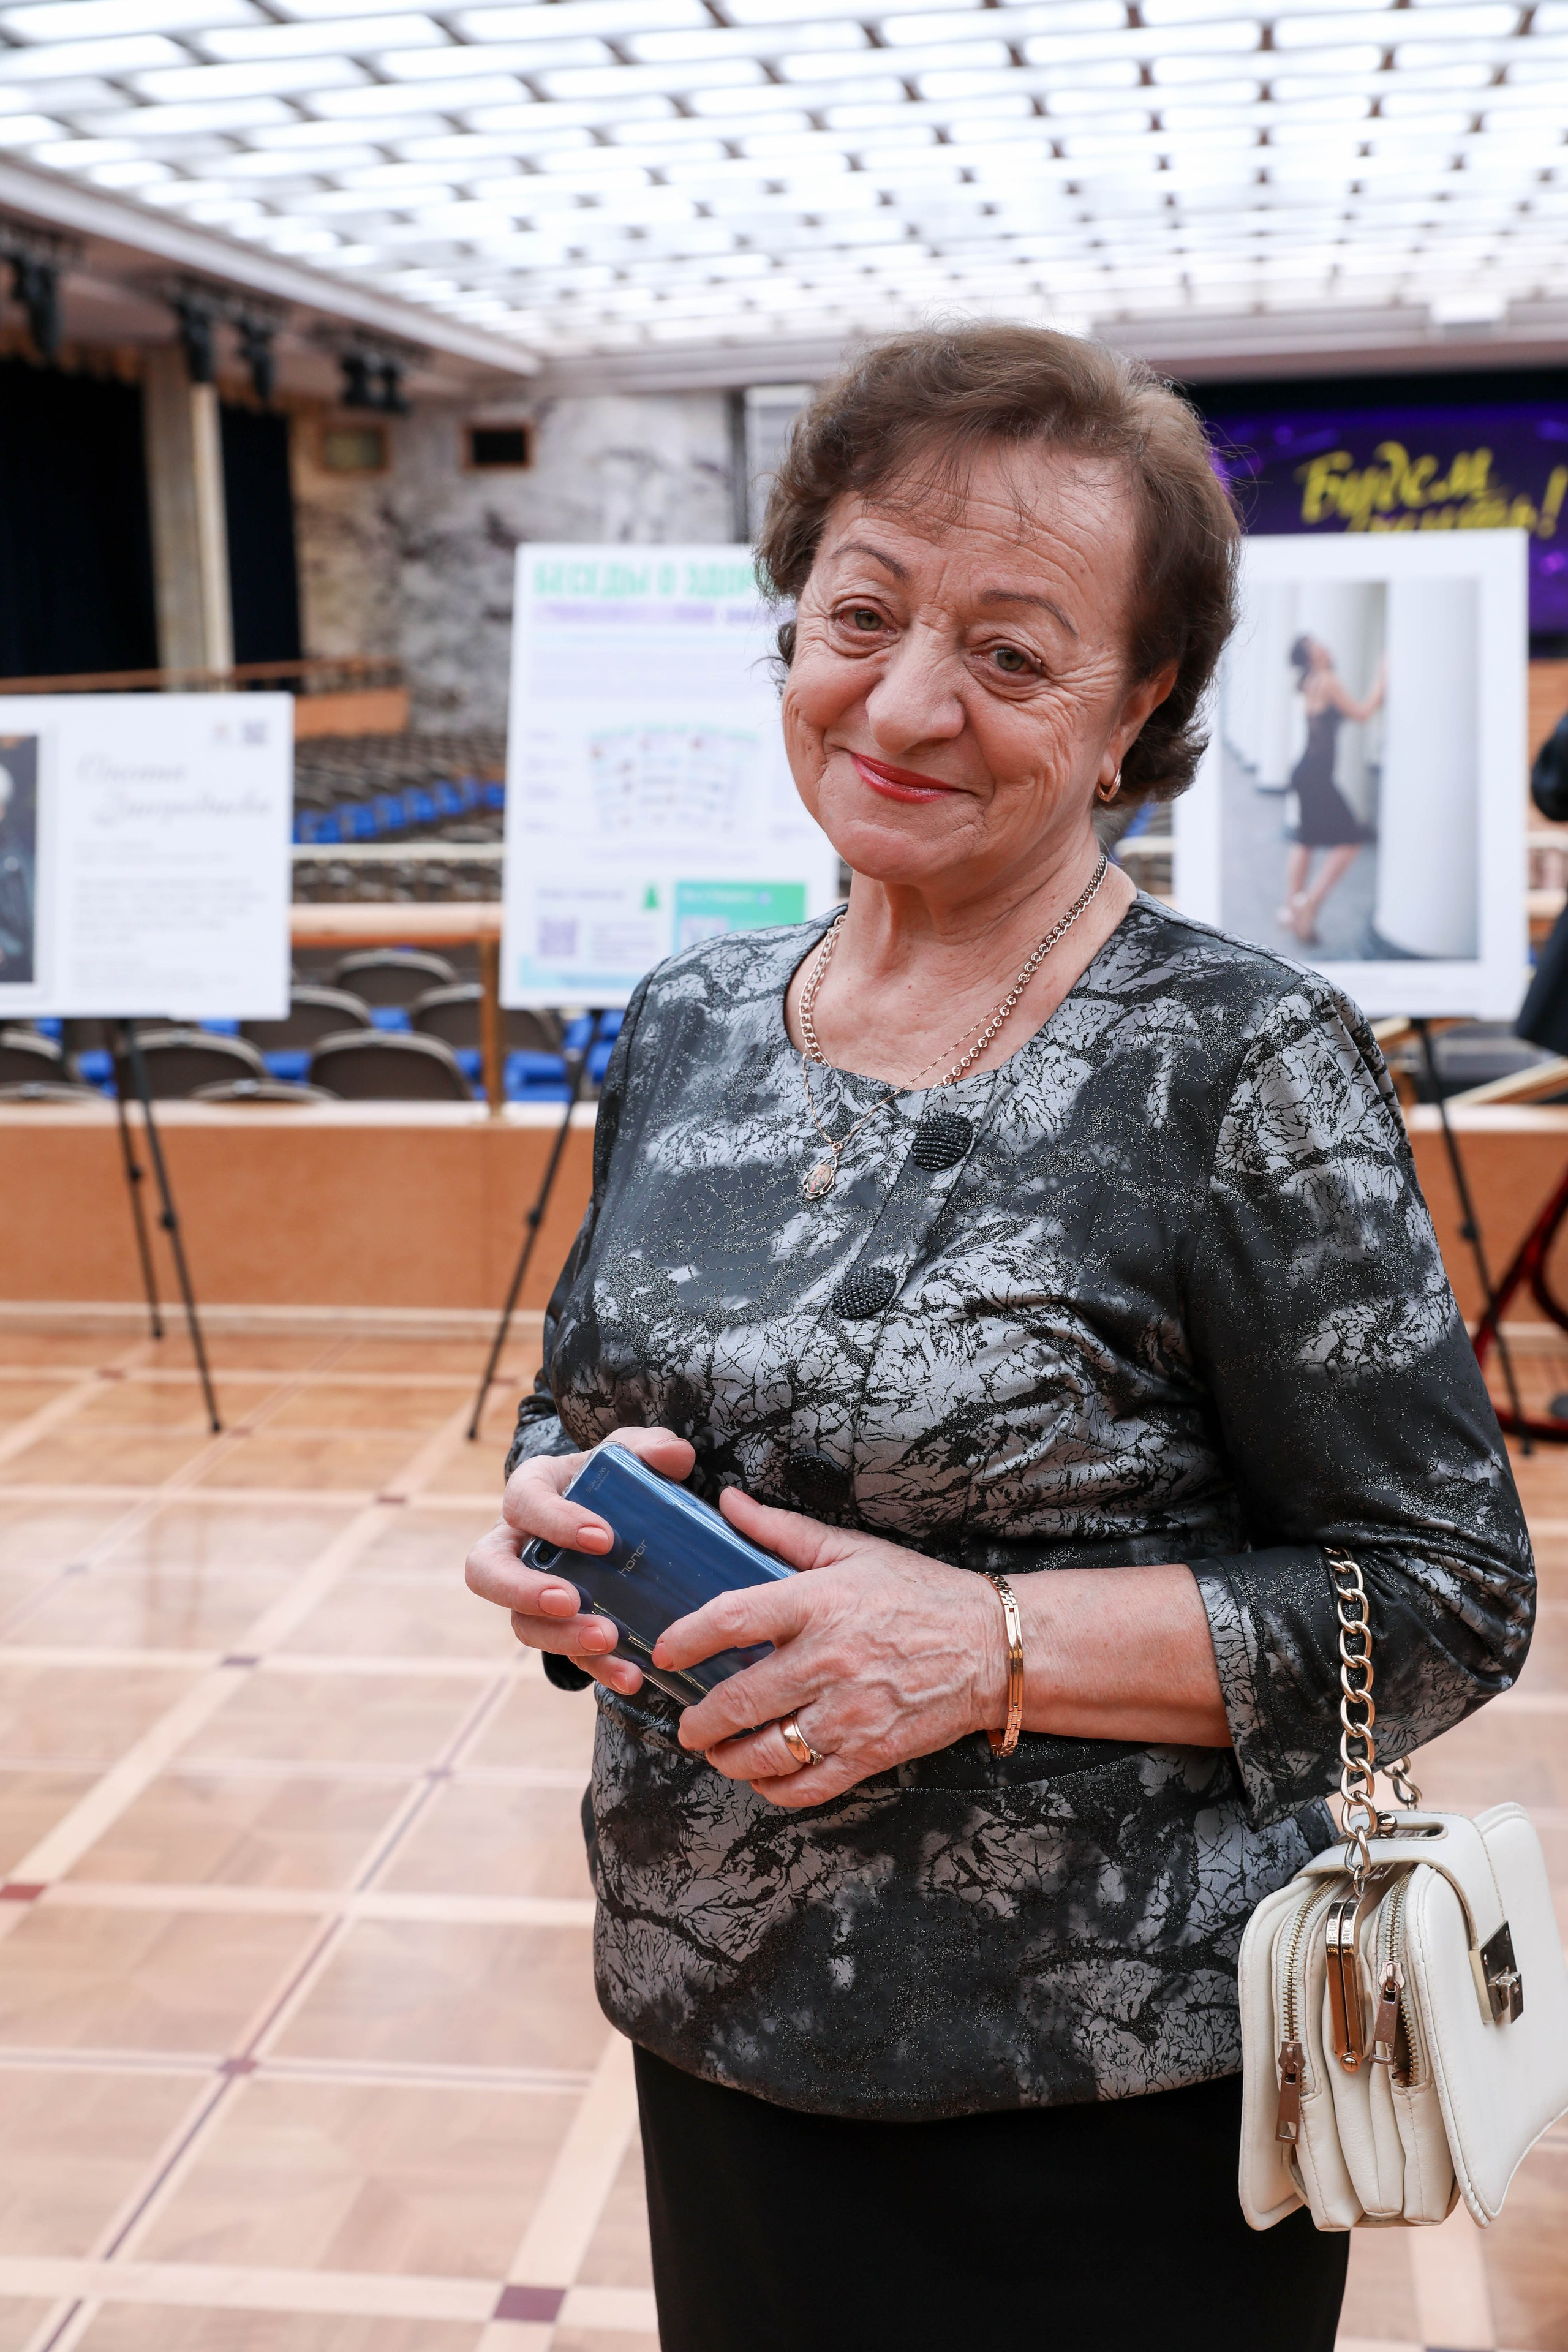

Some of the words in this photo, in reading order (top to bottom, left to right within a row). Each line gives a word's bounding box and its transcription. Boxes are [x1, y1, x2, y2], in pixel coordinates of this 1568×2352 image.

[586, 1479, 598, 1493] DUAL
[595, 1466, 606, 1479] LENS
[617, 1539, 648, 1577] honor
